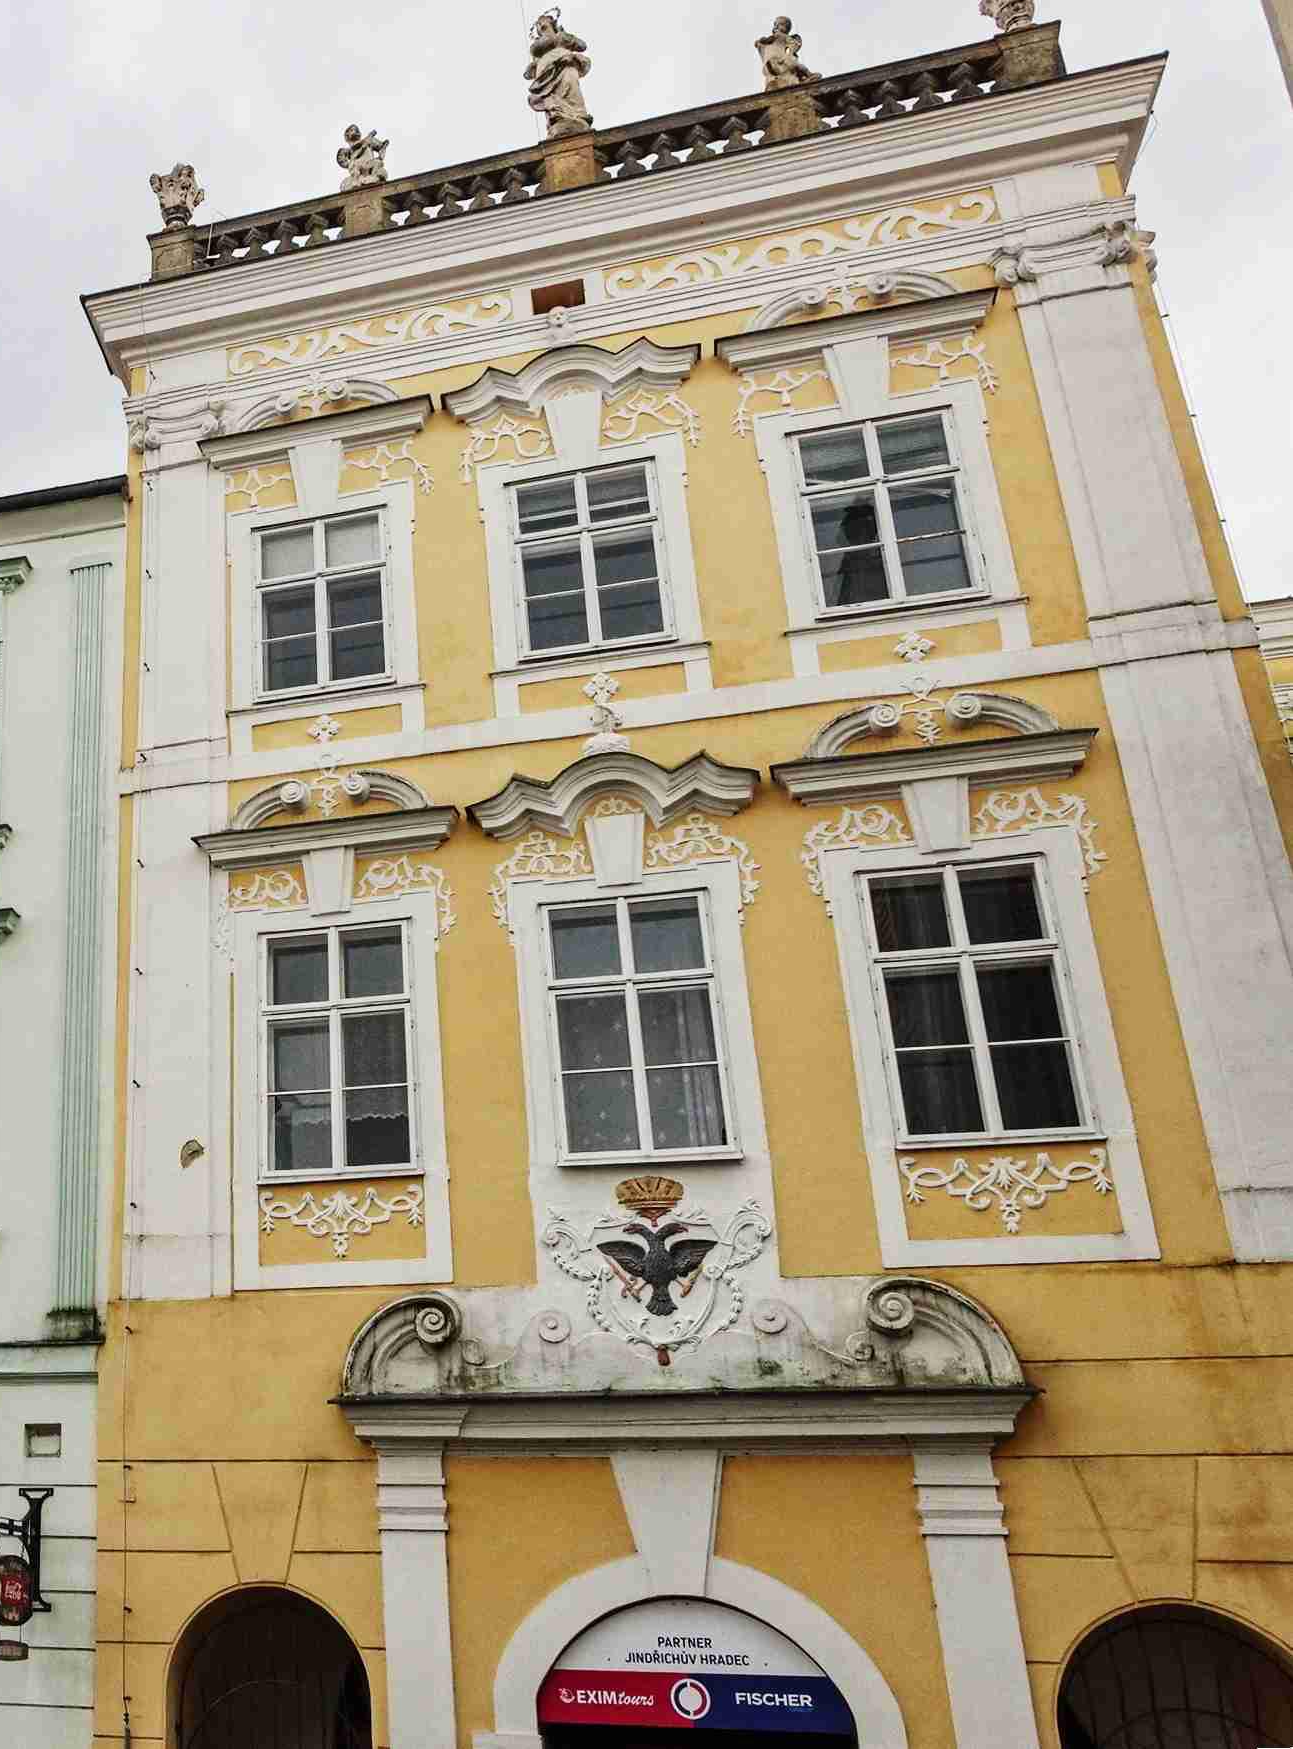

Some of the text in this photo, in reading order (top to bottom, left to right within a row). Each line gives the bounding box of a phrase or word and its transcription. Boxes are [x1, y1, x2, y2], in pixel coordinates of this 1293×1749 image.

[657, 1636, 712, 1649] PARTNER
[625, 1650, 750, 1666] JINDŘICHŮV HRADEC
[577, 1689, 813, 1708] EXIMtours FISCHER
